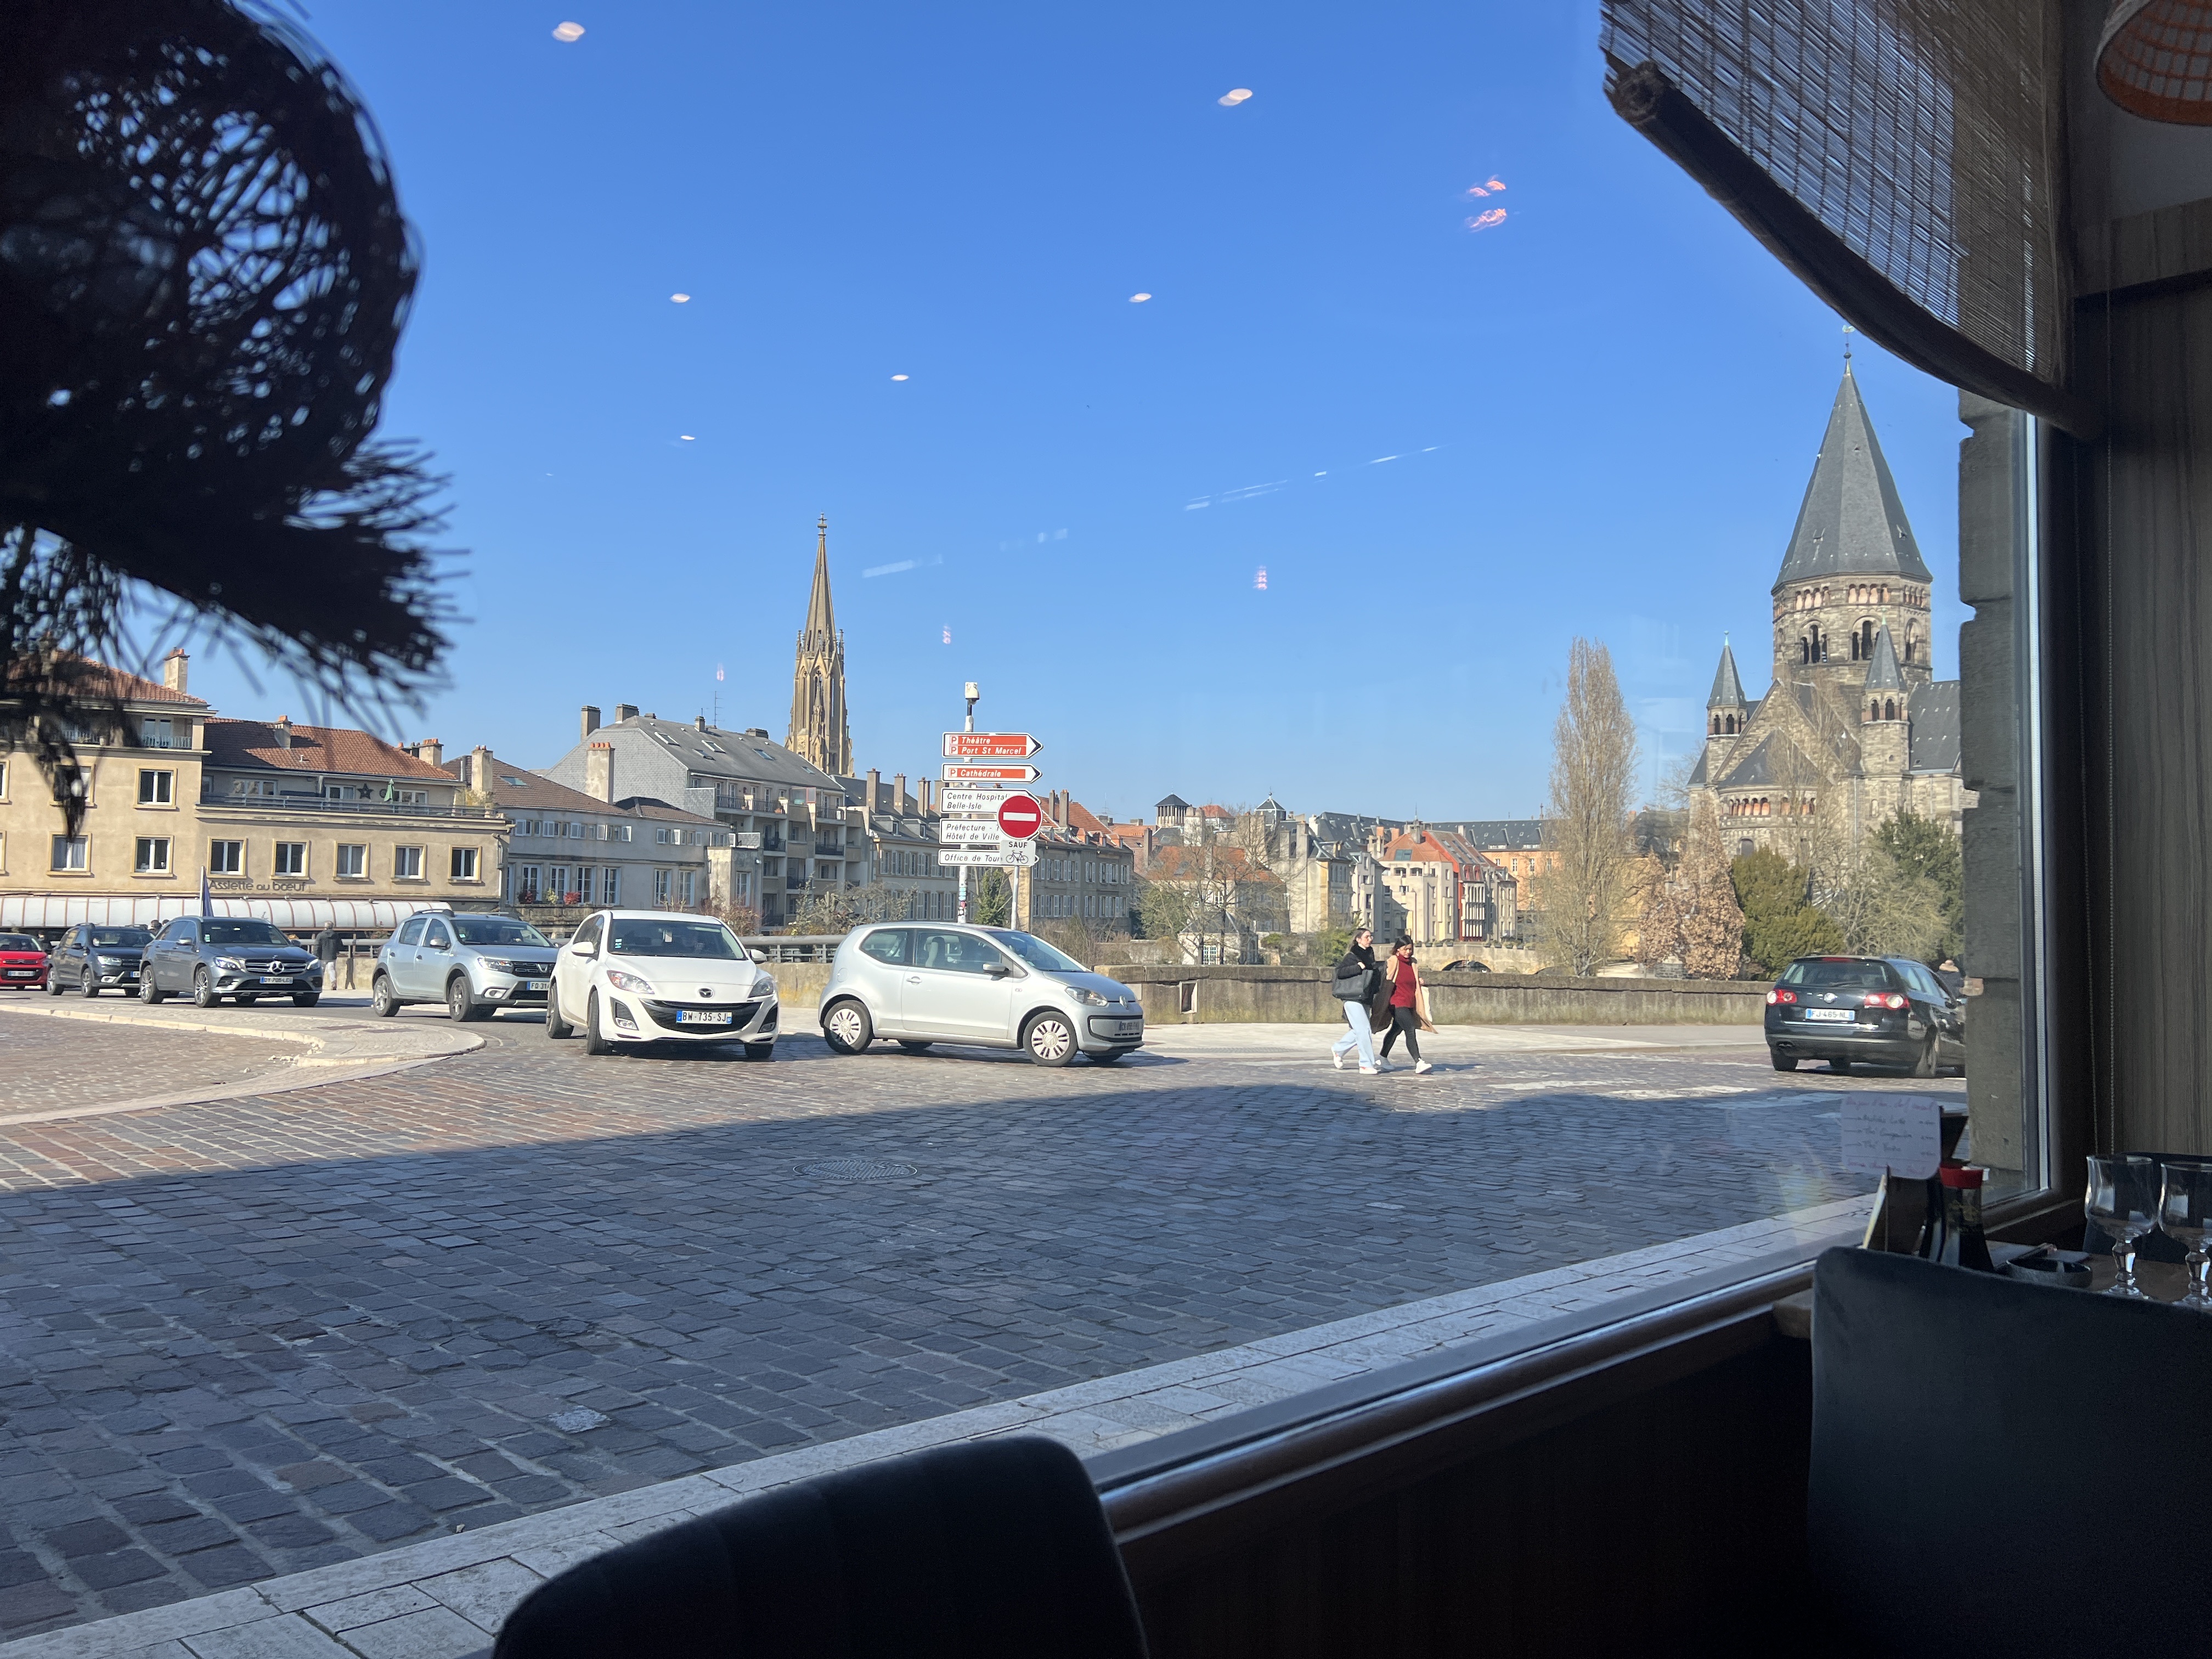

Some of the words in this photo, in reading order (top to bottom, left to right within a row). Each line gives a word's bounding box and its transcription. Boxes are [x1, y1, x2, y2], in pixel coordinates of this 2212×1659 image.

[961, 736, 991, 744] Théâtre
[960, 769, 1002, 777] Cathédrale
[976, 793, 1008, 802] Hospital
[947, 802, 982, 810] Belle-Isle
